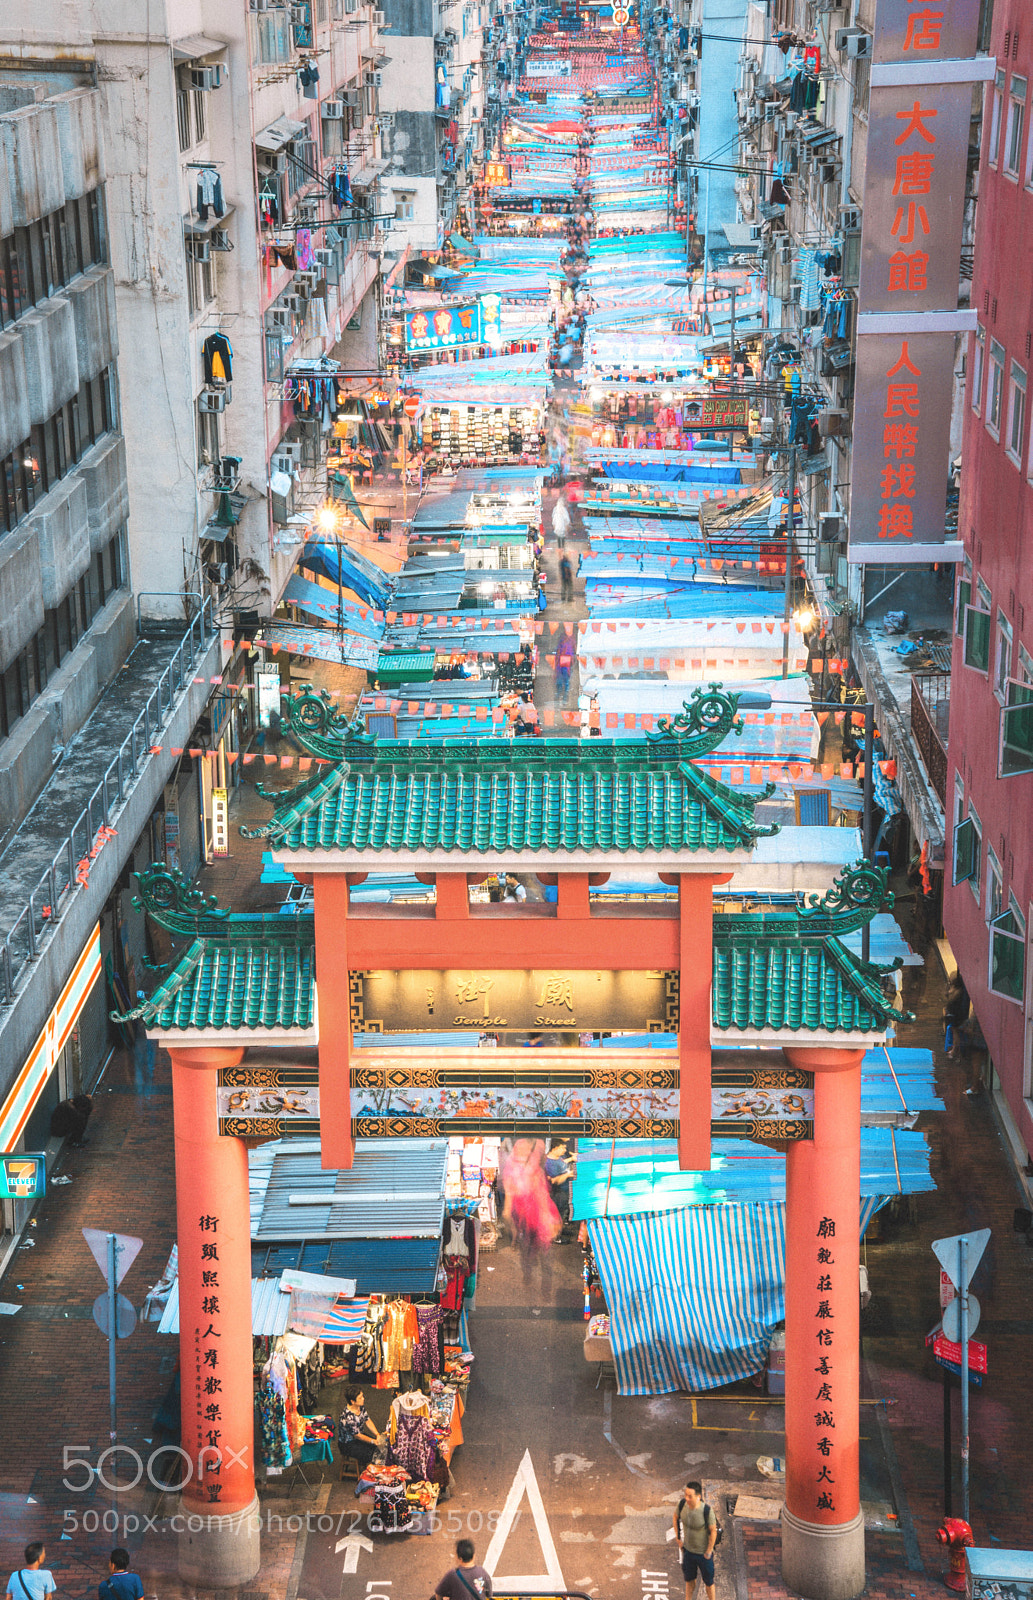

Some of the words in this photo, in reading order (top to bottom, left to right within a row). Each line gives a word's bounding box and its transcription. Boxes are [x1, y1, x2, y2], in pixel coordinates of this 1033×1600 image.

[902, 0, 944, 51] 店
[887, 101, 938, 292] 大唐小館
[704, 401, 715, 413] ASIAN
[716, 401, 729, 413] CURRY
[729, 401, 745, 413] KITCHEN
[877, 341, 922, 539] 人民幣找換
[262, 663, 279, 674] 124
[452, 1016, 508, 1027] Temple
[533, 1016, 577, 1027] Street
